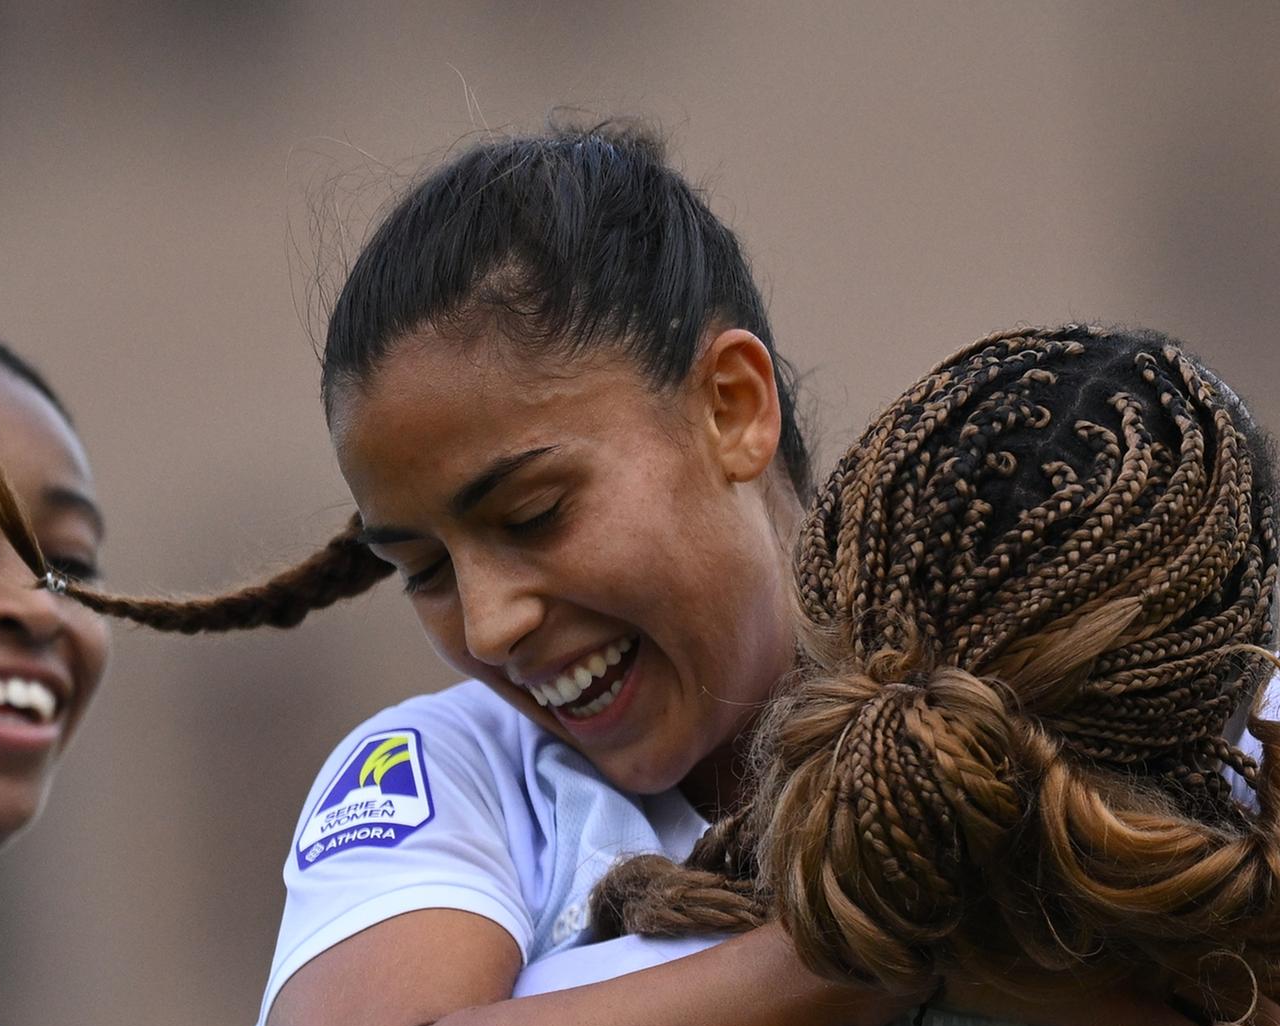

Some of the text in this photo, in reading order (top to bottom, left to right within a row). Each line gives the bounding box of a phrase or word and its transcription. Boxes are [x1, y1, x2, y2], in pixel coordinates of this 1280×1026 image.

[320, 809, 396, 833] WOMEN
[324, 799, 395, 823] SERIE A
[325, 827, 396, 851] ATHORA
